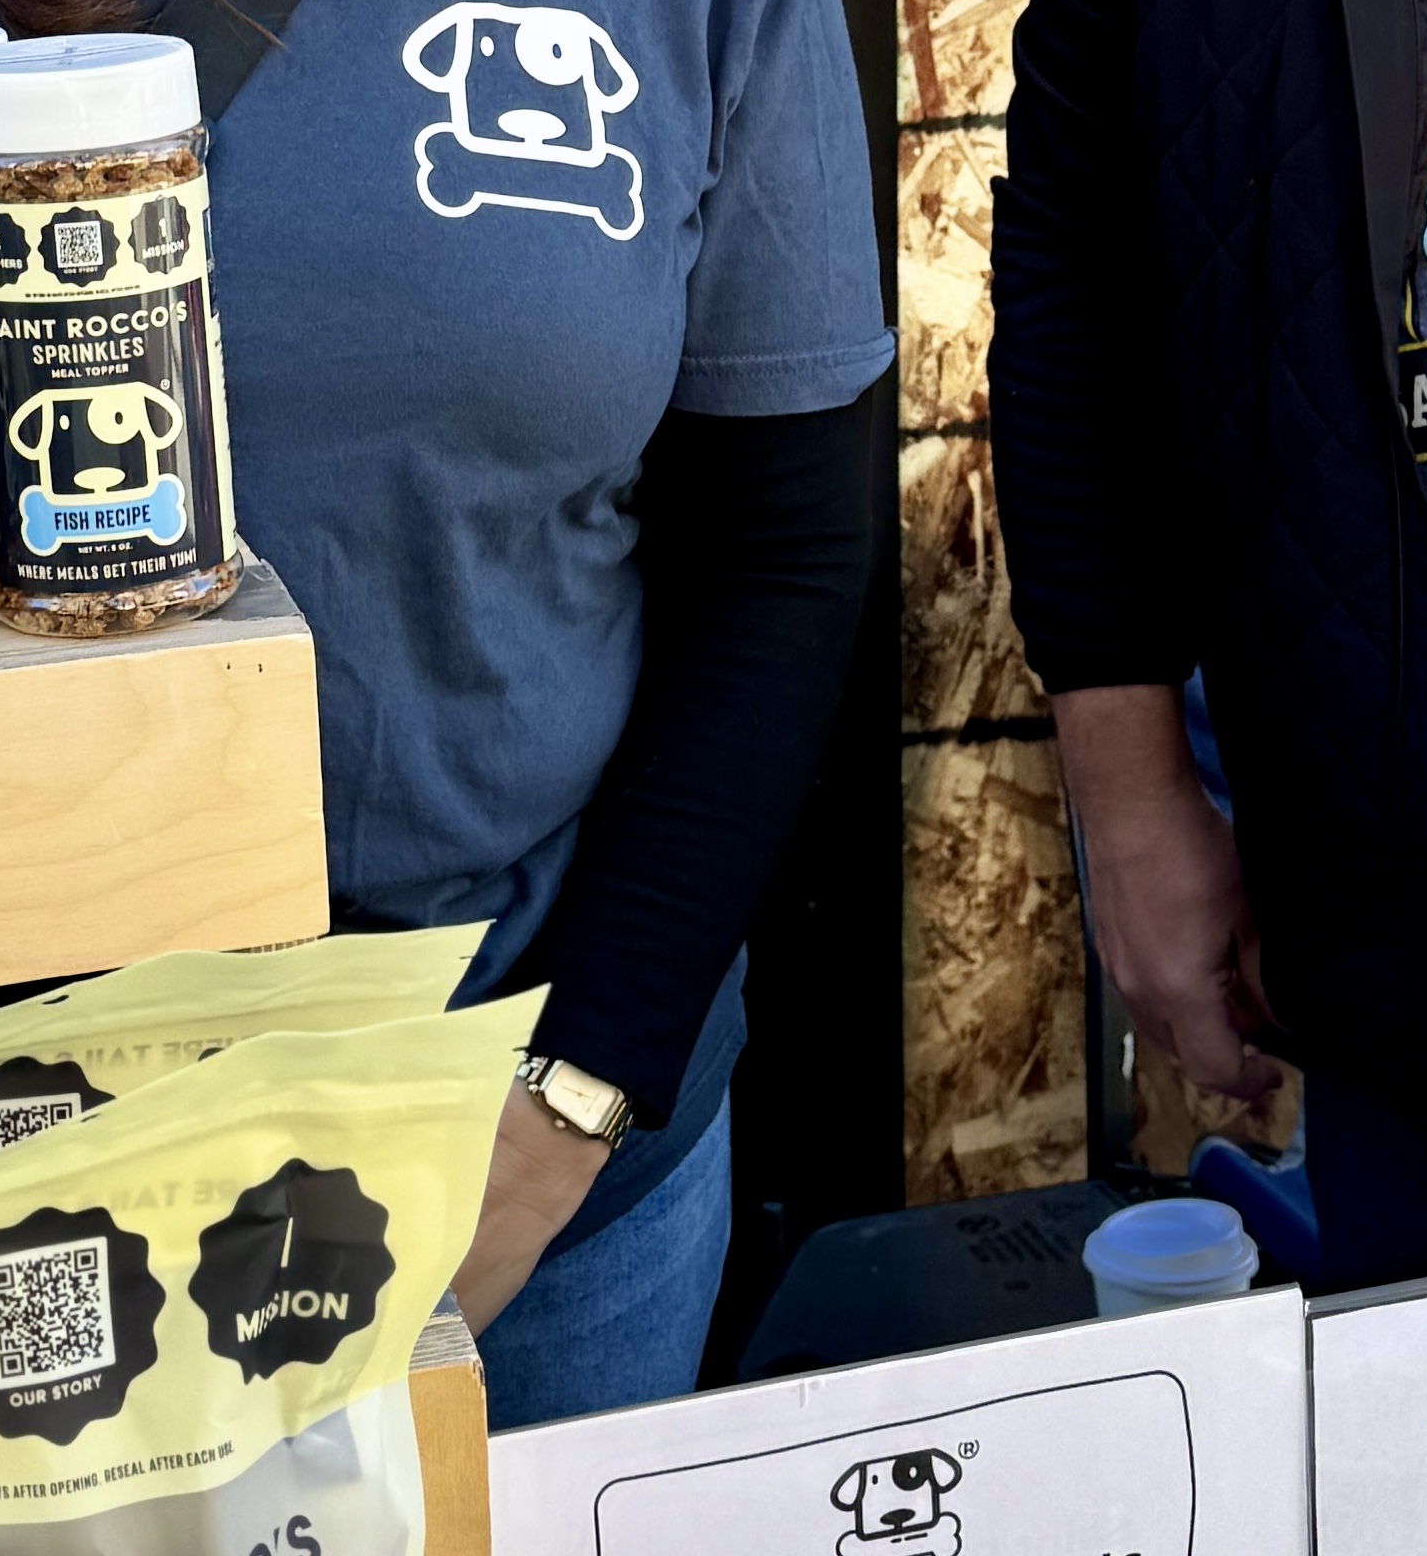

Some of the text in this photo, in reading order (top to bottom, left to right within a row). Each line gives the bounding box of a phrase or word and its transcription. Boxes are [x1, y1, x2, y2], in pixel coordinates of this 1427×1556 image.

[68, 306, 188, 338] ROCCO'S
[32, 337, 144, 364] SPRINKLES
[54, 504, 152, 530] FISH RECIPE
[17, 564, 53, 580] WHERE
[57, 566, 98, 580] MEALS
[103, 563, 126, 578] GET
[131, 557, 166, 575] THEIR
[236, 1290, 349, 1343] MISSION
[9, 1375, 101, 1407] OUR STORY
[13, 1484, 46, 1498] AFTER
[50, 1473, 103, 1496] OPENING.
[104, 1461, 145, 1483] RESEAL
[149, 1454, 183, 1472] AFTER
[186, 1449, 216, 1467] EACH
